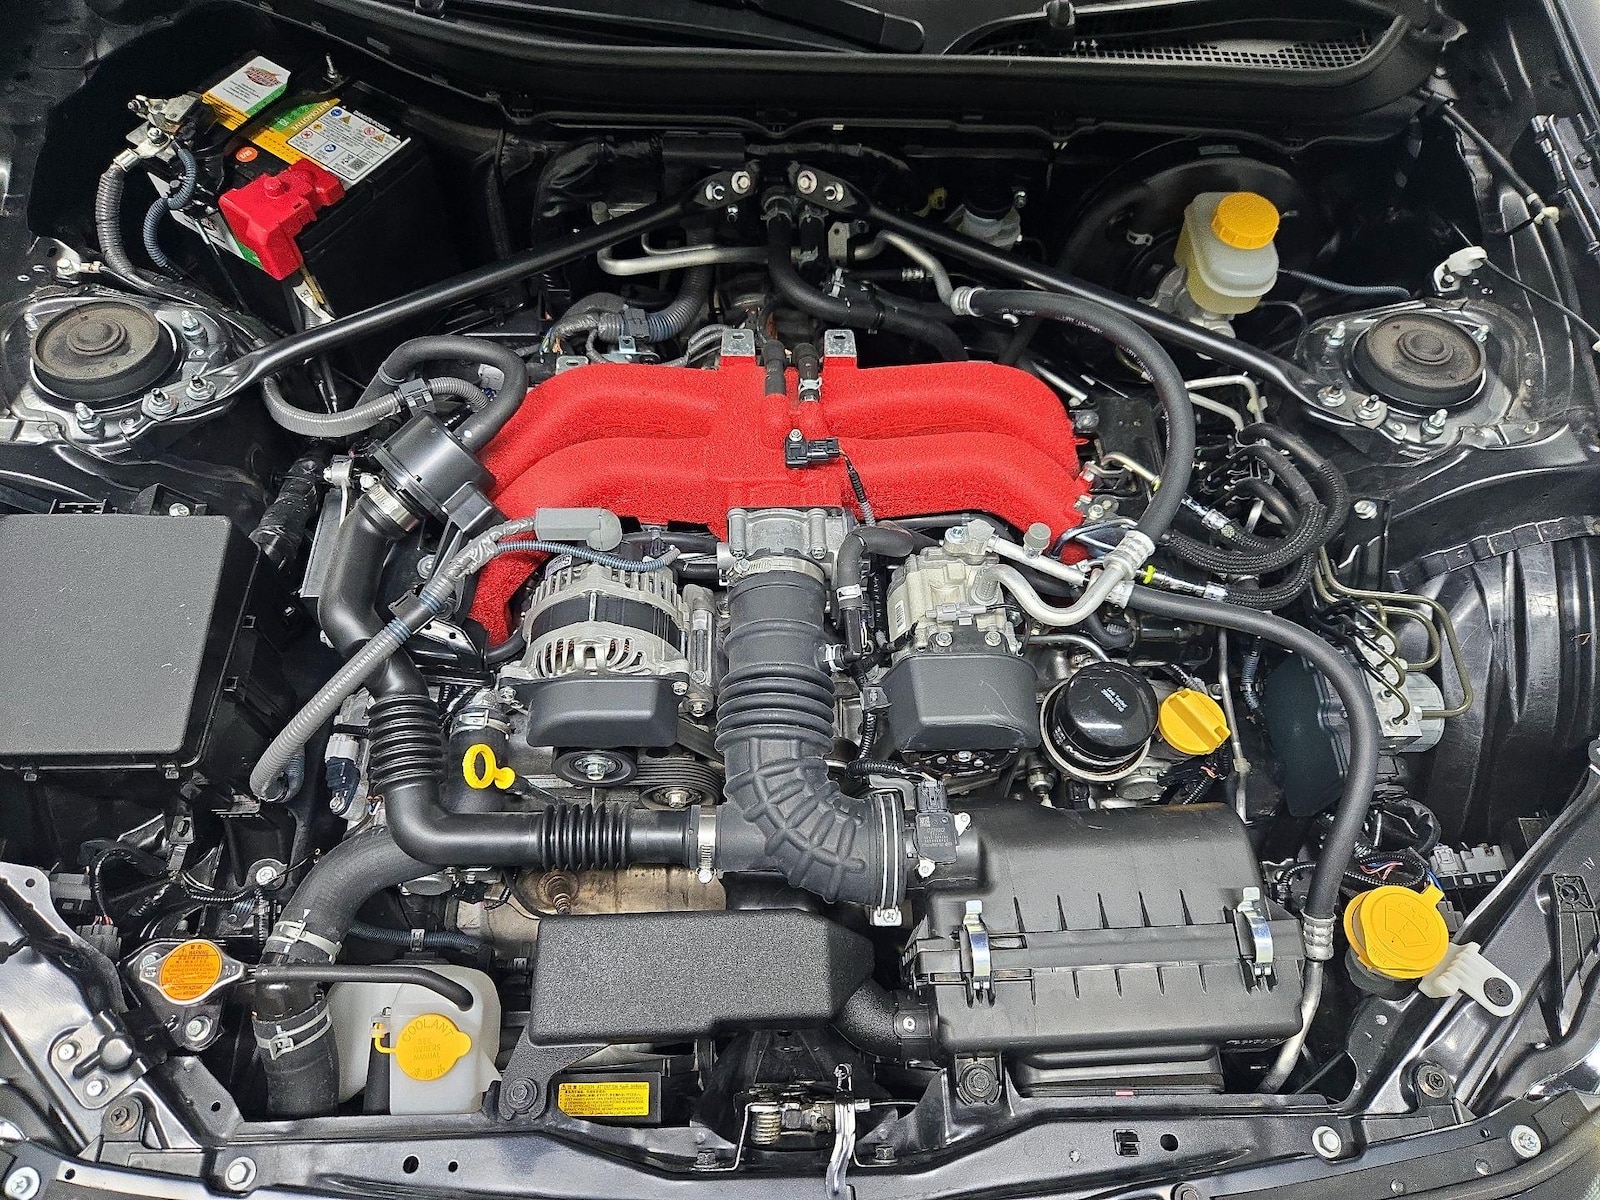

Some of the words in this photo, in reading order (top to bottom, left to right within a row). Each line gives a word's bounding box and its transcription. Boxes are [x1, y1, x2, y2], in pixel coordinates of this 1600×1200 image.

[290, 101, 330, 130] AUTOMOTIVE
[1369, 947, 1387, 966] PULL
[402, 1019, 454, 1042] COOLANT
[416, 1037, 432, 1045] SEE
[413, 1051, 441, 1061] MANUAL
